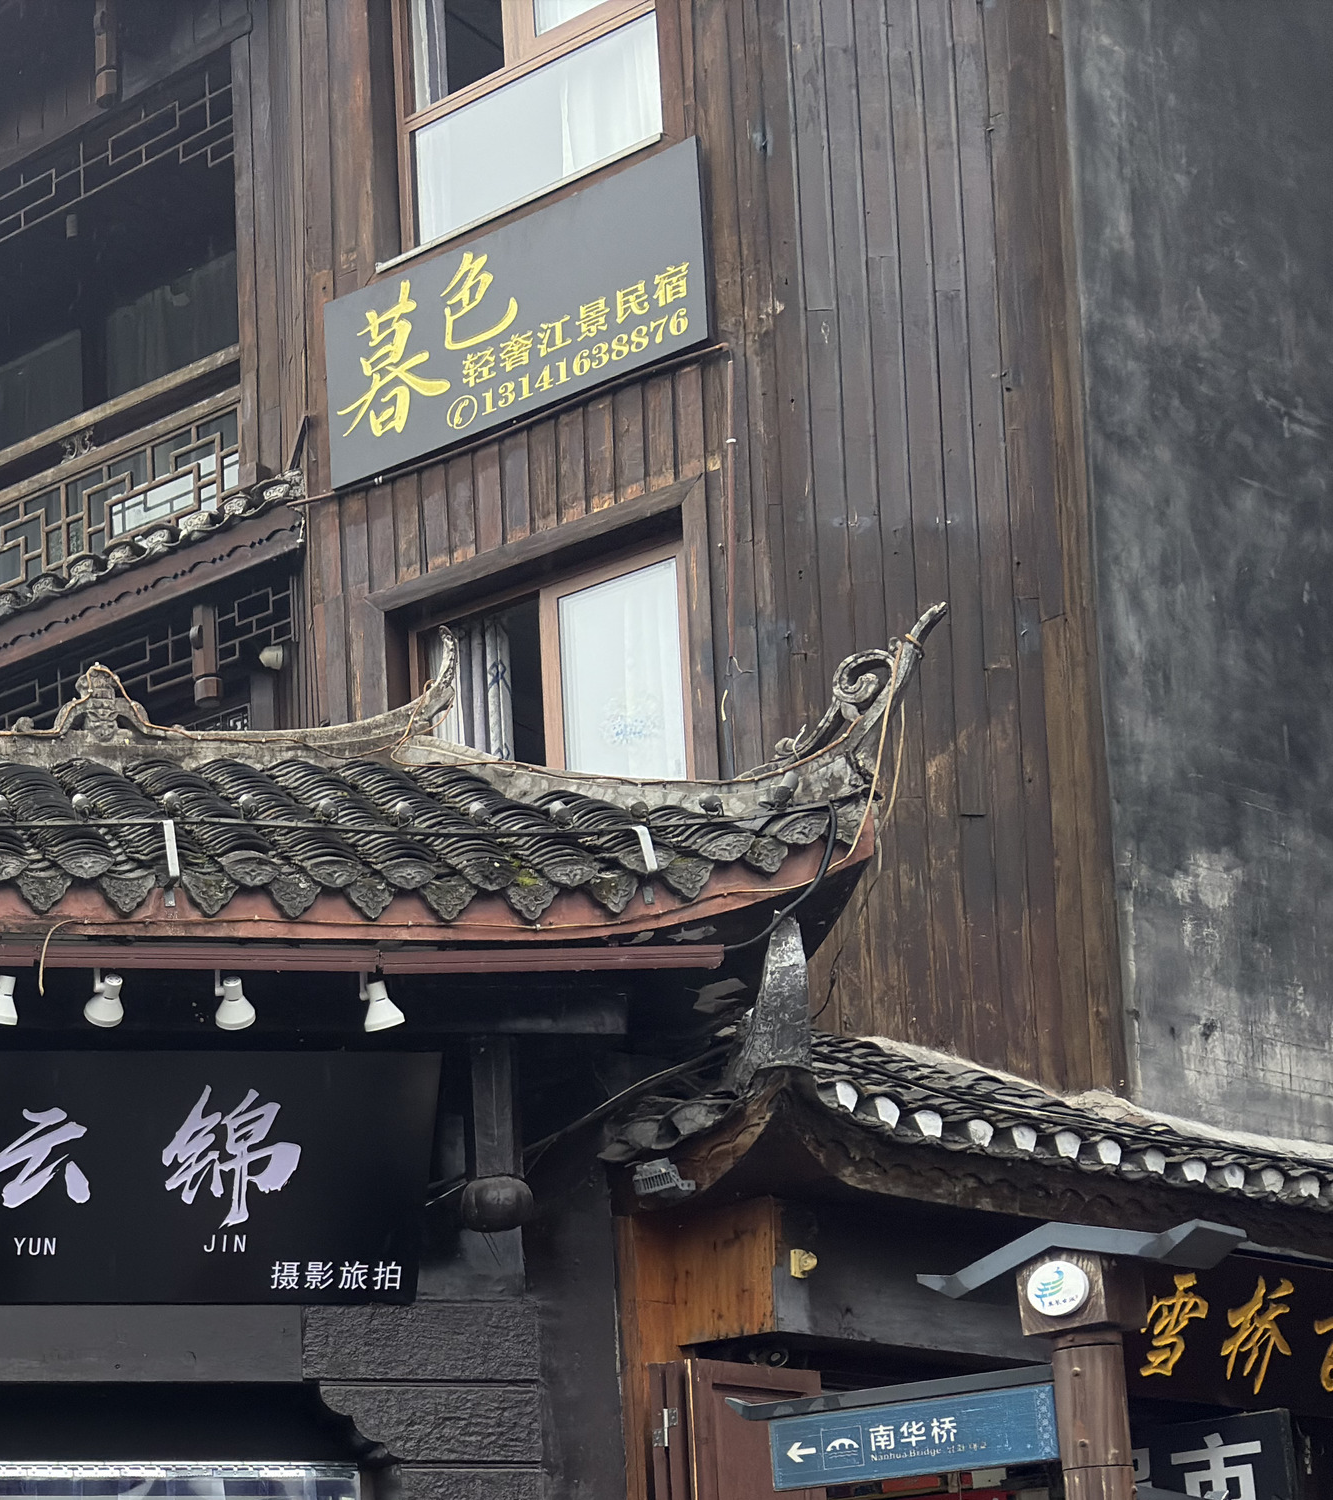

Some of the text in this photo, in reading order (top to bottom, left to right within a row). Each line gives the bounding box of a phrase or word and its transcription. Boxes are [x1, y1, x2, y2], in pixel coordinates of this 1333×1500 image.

[336, 251, 519, 437] 暮色
[462, 261, 690, 389] 轻奢江景民宿
[481, 307, 689, 417] 13141638876
[14, 1235, 247, 1255] YUN JIN
[271, 1261, 403, 1291] 摄影旅拍
[1139, 1272, 1333, 1395] 雪桥
[869, 1417, 957, 1451] 南华桥
